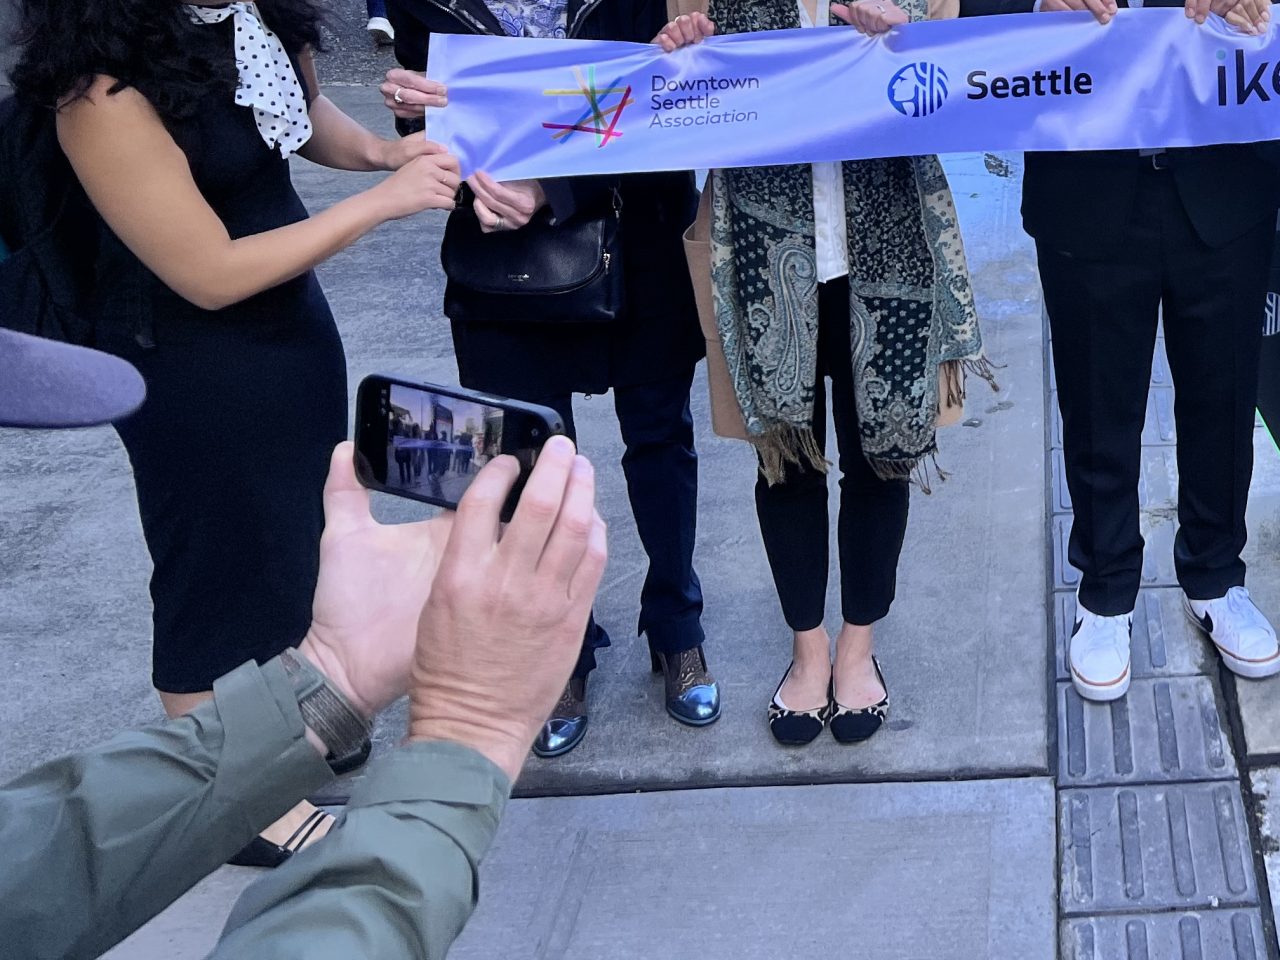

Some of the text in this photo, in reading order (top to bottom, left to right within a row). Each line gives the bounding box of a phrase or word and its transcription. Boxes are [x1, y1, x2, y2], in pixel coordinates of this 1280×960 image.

[651, 74, 760, 93] Downtown
[967, 65, 1093, 100] Seattle
[650, 93, 720, 111] Seattle
[648, 109, 759, 130] Association
